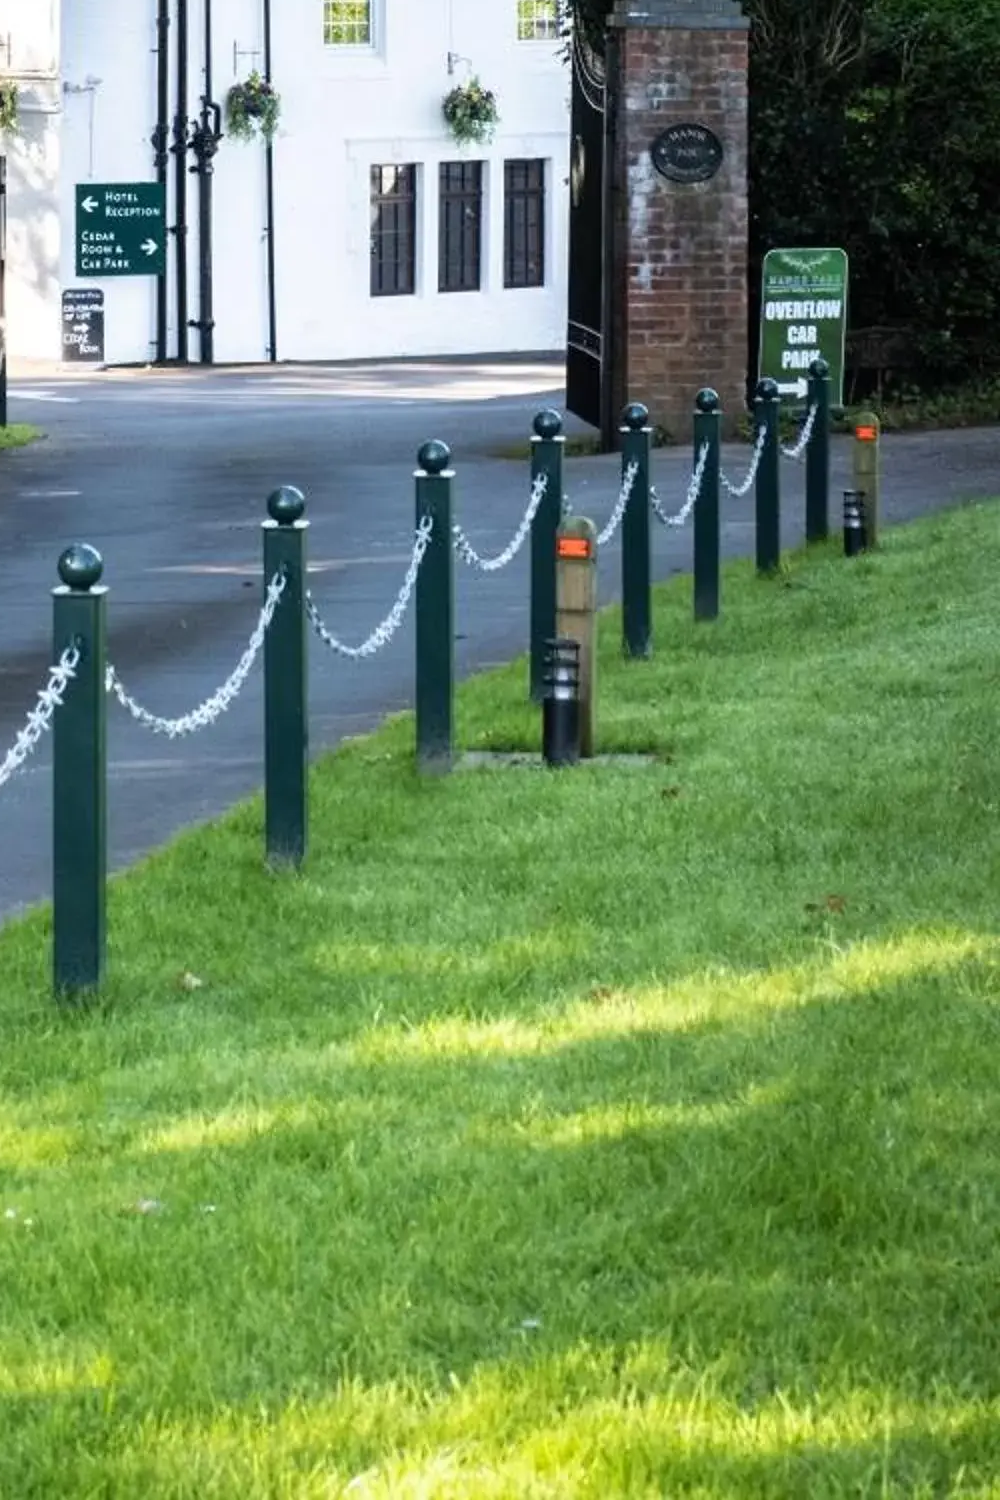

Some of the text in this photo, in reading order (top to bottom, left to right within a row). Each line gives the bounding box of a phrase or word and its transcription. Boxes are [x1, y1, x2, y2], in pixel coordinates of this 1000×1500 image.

[765, 299, 841, 320] OVERFLOW
[787, 325, 817, 345] CAR
[781, 349, 821, 370] PARK
